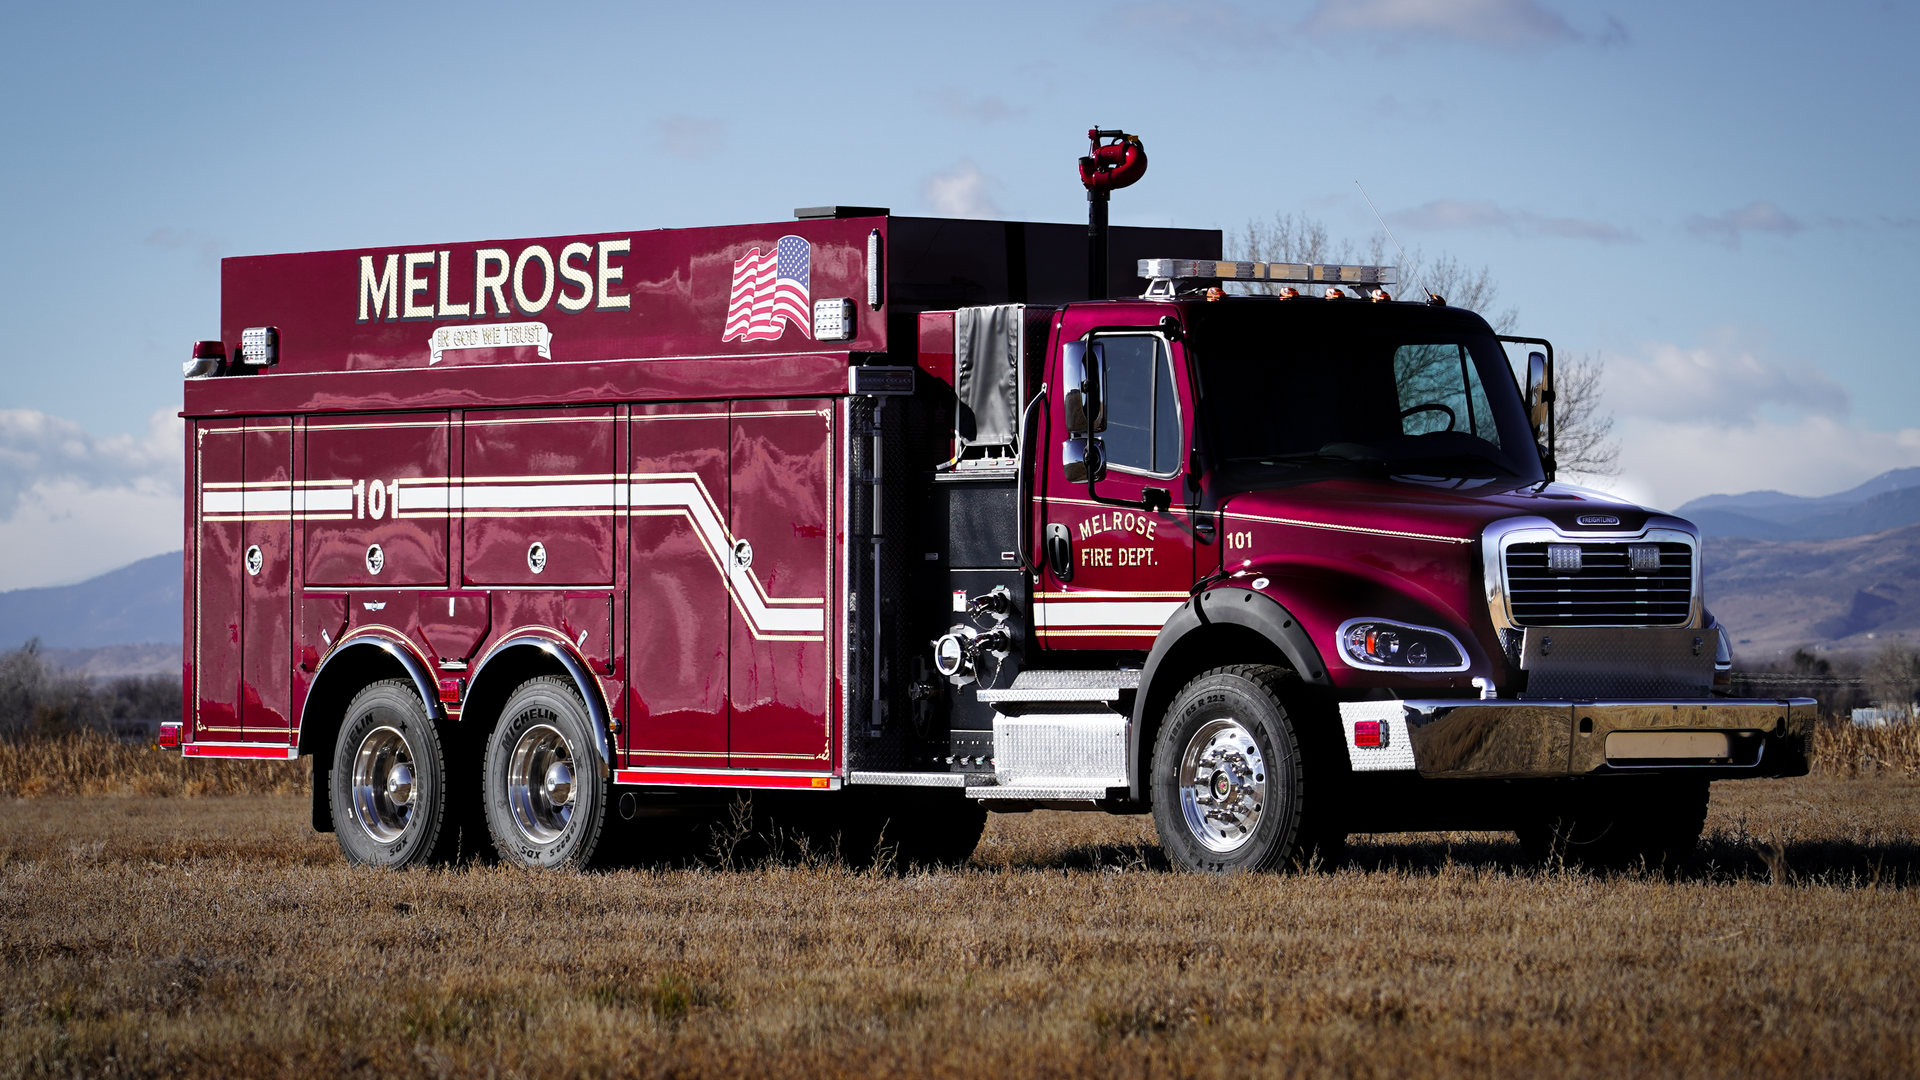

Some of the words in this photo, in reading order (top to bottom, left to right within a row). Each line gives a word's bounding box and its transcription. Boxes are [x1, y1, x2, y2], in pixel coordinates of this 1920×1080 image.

[357, 237, 631, 322] MELROSE
[437, 329, 450, 347] IN
[453, 328, 478, 346] GOD
[482, 327, 501, 345] WE
[505, 325, 543, 343] TRUST
[353, 479, 399, 520] 101
[1078, 511, 1158, 542] MELROSE
[1226, 531, 1252, 549] 101
[1081, 548, 1113, 567] FIRE
[1118, 547, 1158, 567] DEPT.
[501, 707, 558, 750] MICHELIN
[339, 711, 374, 795] MICHELIN
[389, 836, 408, 857] XDS
[521, 845, 541, 860] XDS
